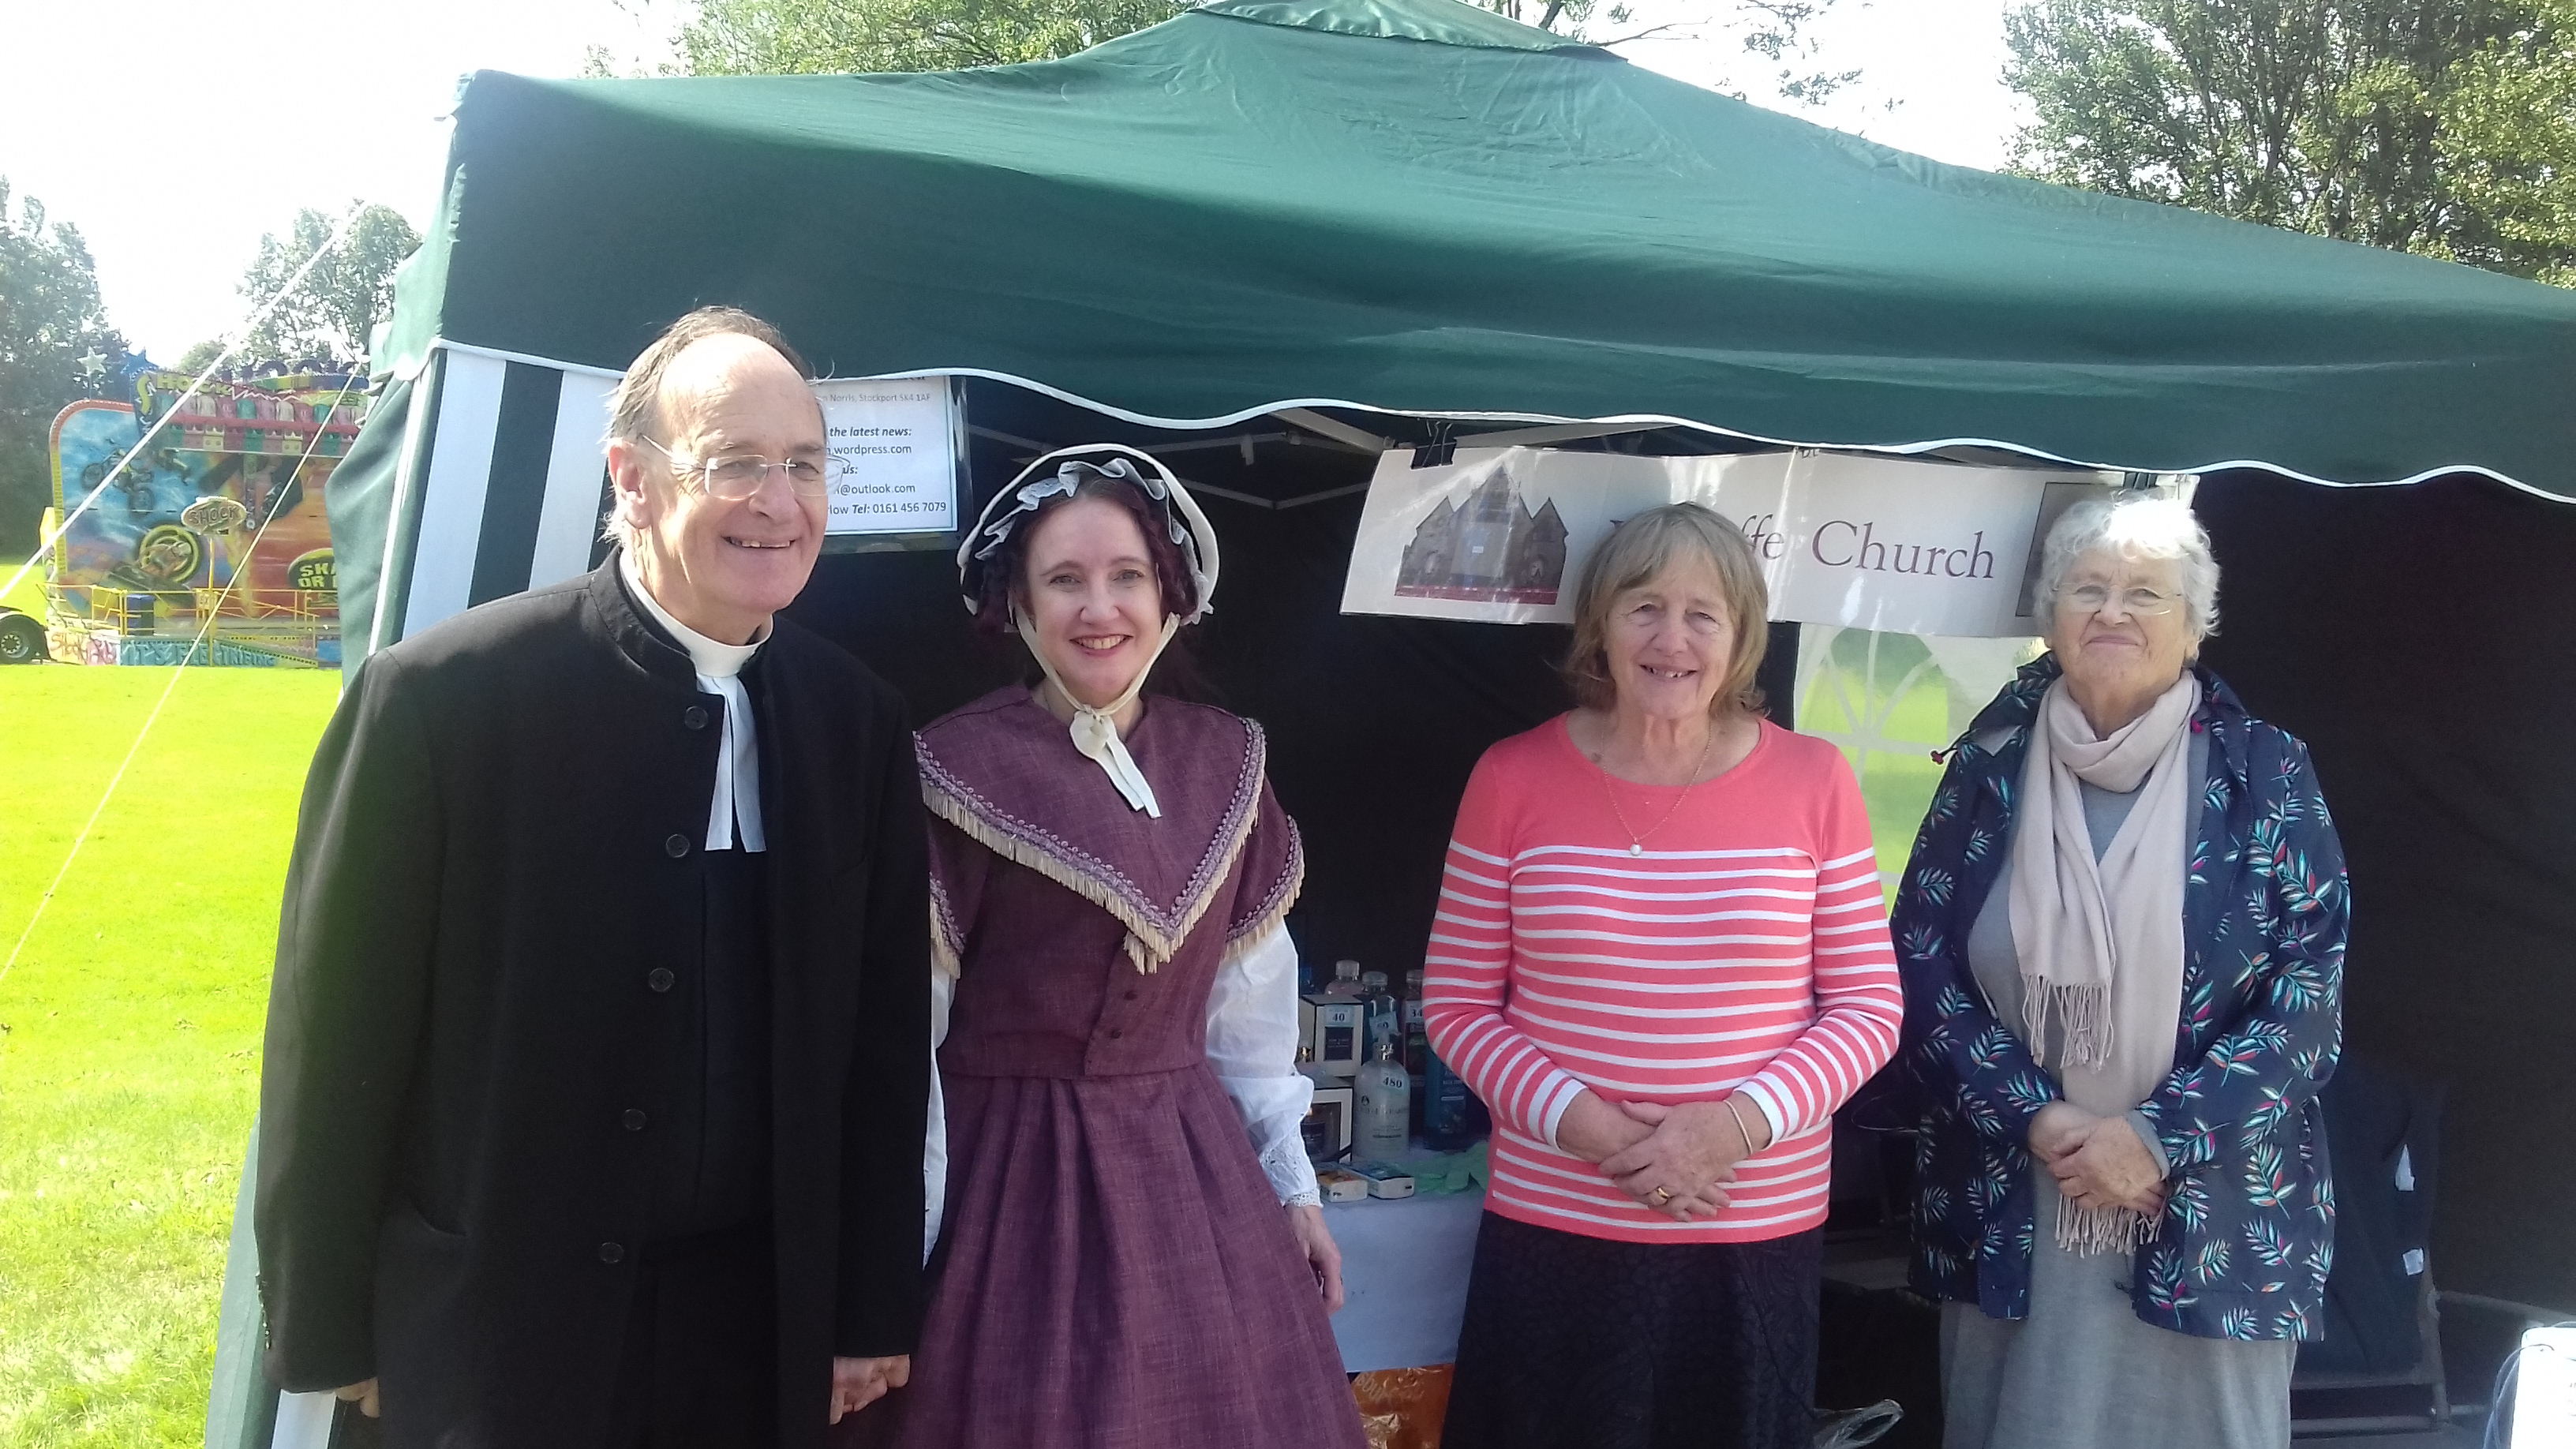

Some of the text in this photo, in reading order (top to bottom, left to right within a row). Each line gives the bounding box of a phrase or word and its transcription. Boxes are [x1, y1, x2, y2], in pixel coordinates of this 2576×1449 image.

[859, 394, 897, 403] Stockport
[829, 427, 912, 437] the latest news:
[828, 502, 947, 515] low Tel: 0161 456 7079
[189, 506, 240, 525] SHOCK
[1811, 519, 1995, 579] Church
[298, 577, 325, 588] OR
[1332, 1013, 1346, 1022] 40
[1383, 1076, 1403, 1088] 480
